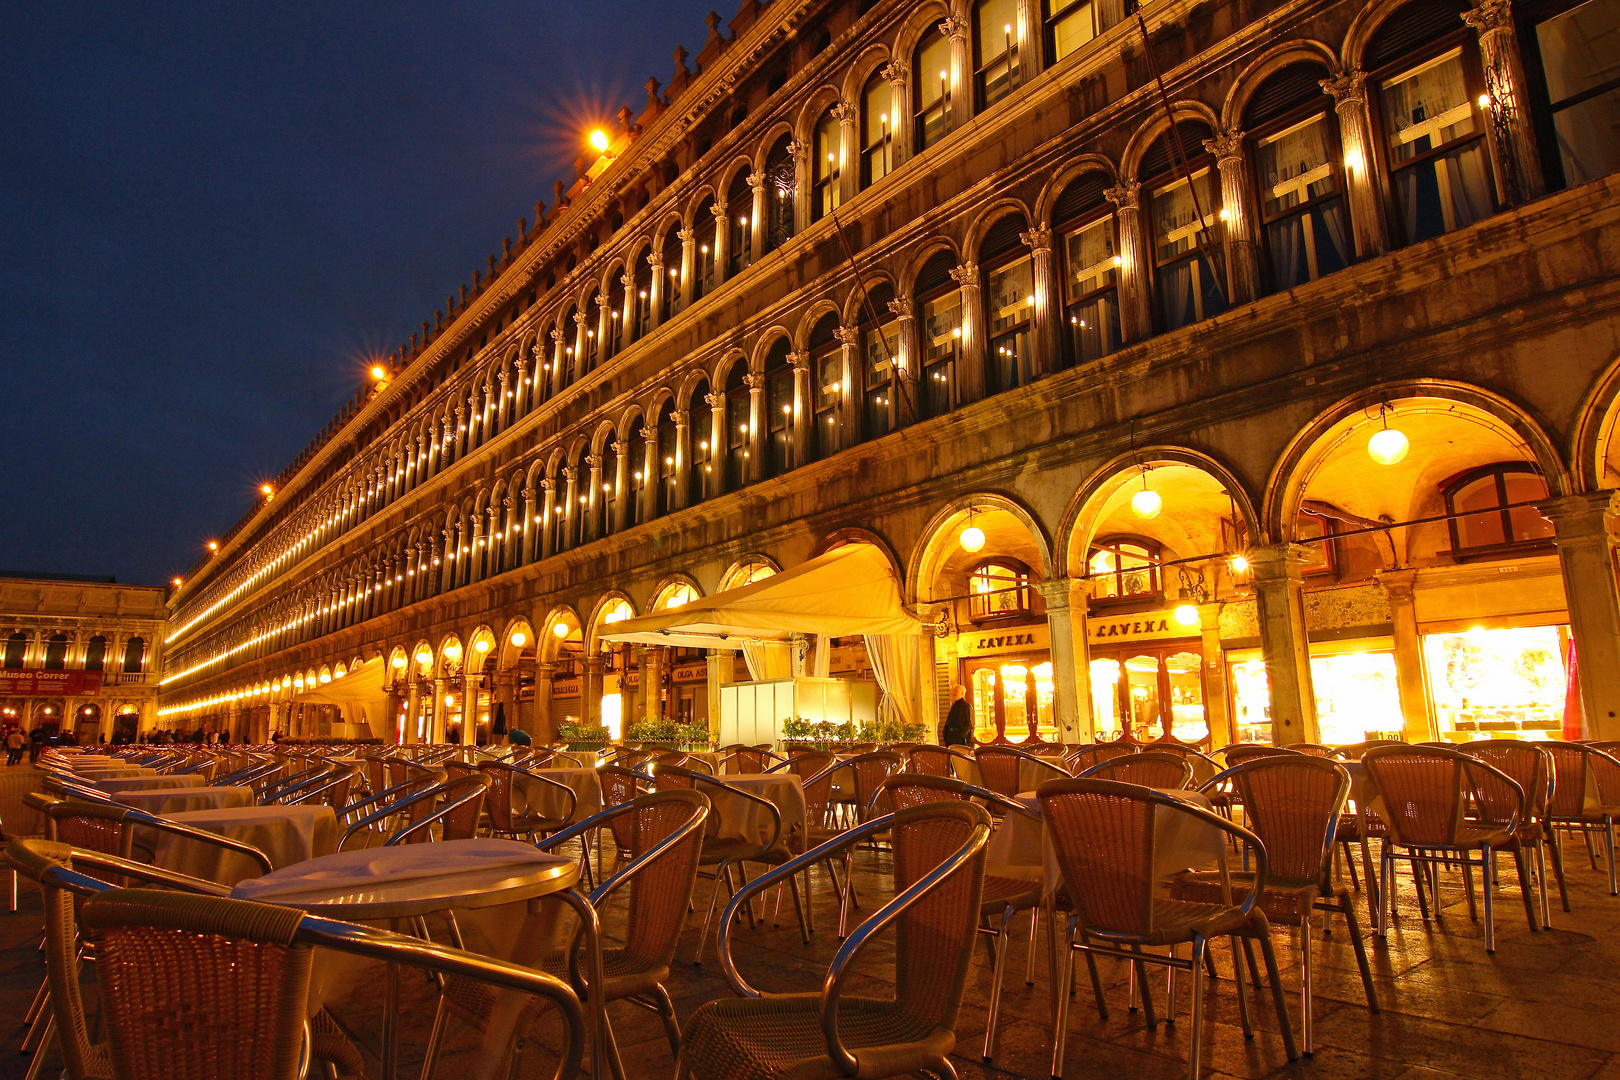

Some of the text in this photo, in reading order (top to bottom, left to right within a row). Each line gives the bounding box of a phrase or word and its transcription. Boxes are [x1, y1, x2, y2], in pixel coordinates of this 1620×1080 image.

[0, 671, 70, 680] Museo Correr
[677, 670, 693, 679] OLGA
[626, 675, 640, 684] OLG
